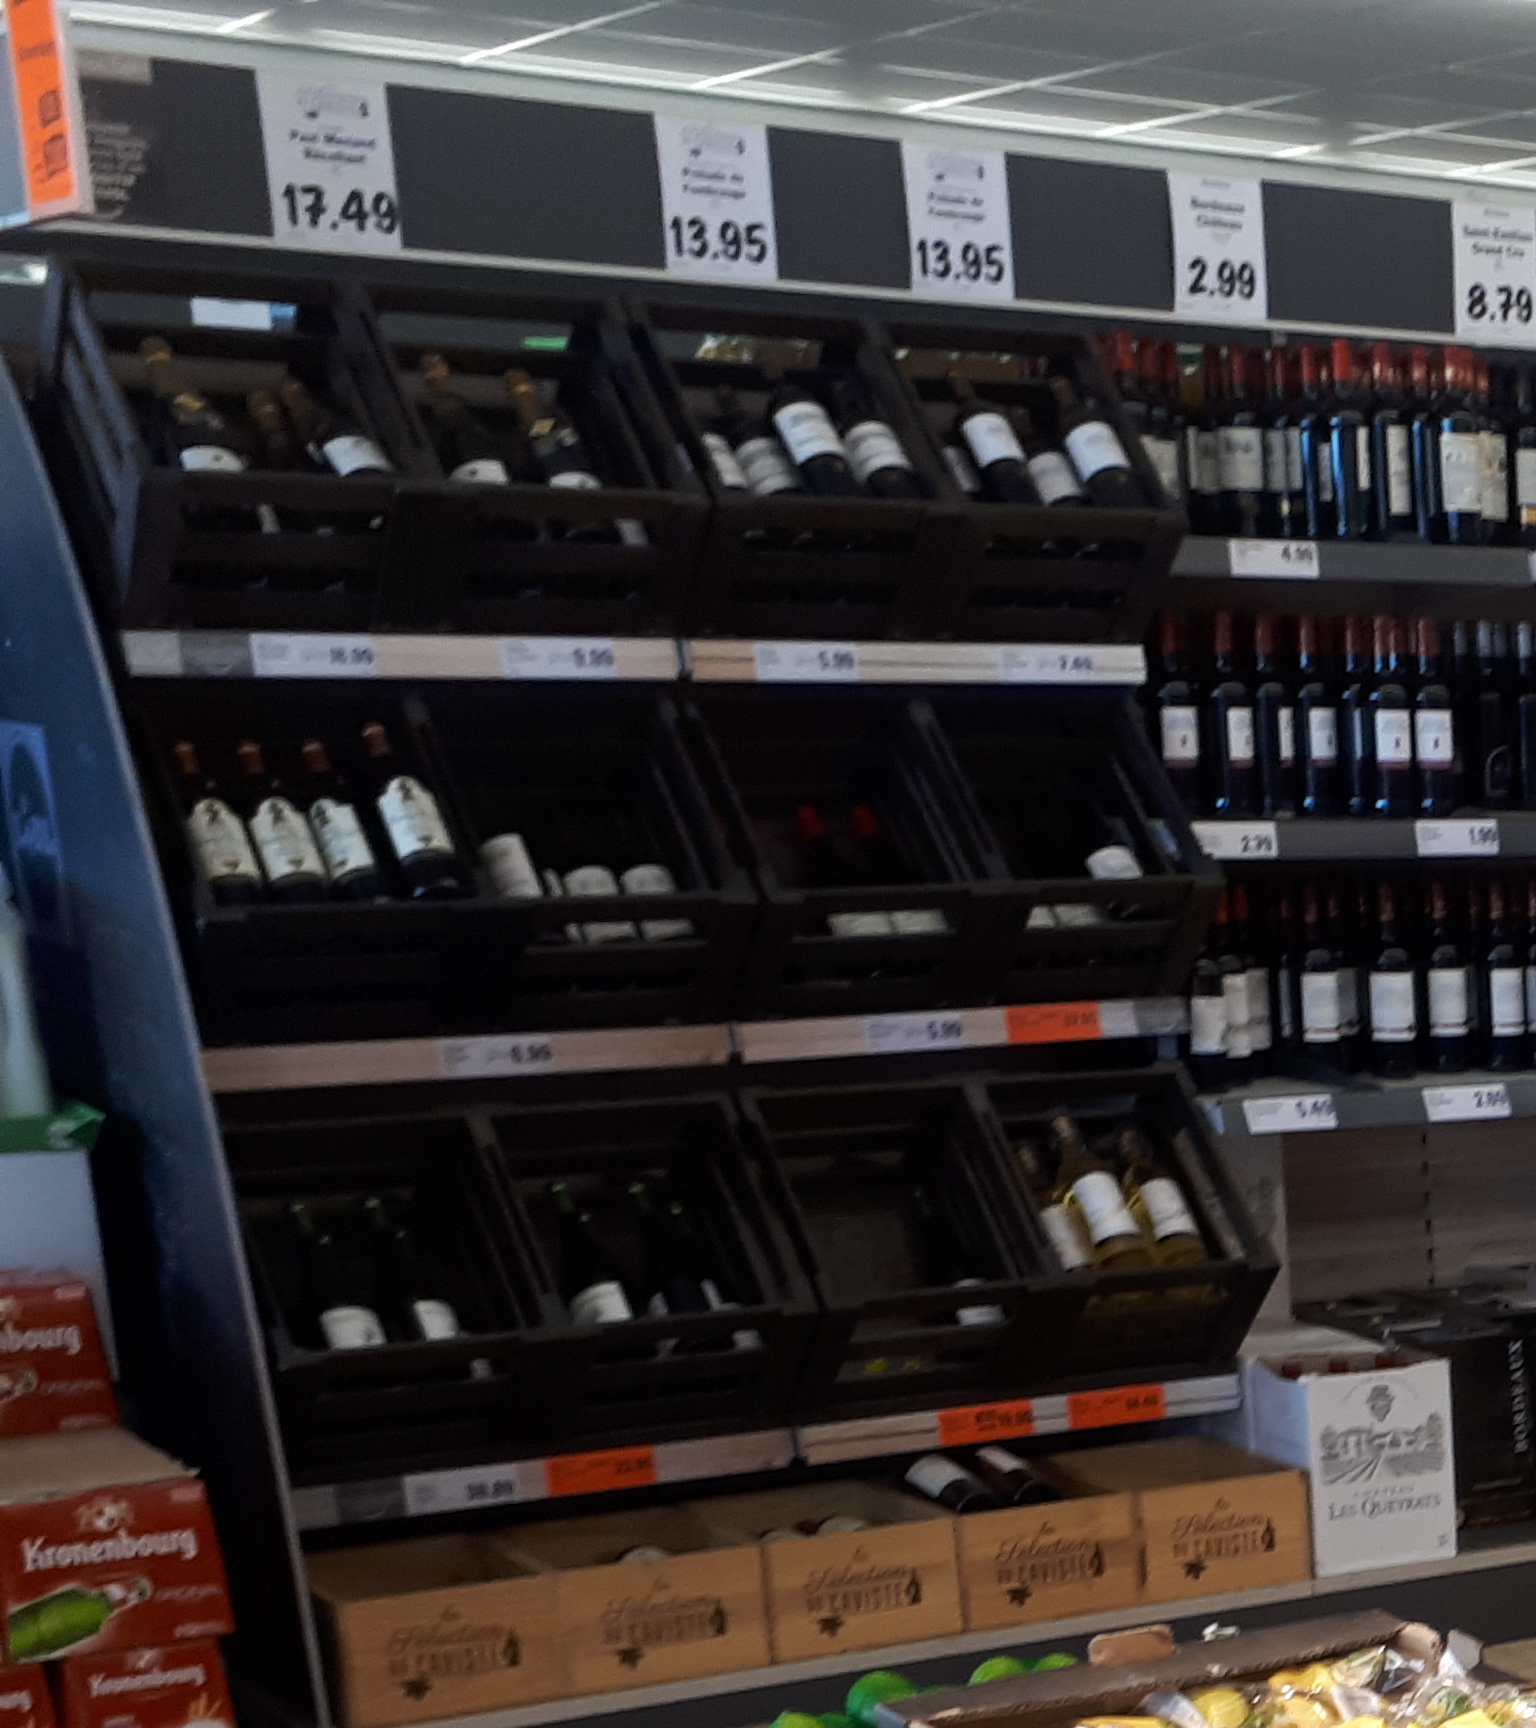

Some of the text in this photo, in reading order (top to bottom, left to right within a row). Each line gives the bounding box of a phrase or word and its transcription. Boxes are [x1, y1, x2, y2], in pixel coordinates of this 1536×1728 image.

[281, 181, 397, 234] 17.49
[670, 215, 768, 263] 13.95
[916, 238, 1005, 282] 13.95
[1187, 256, 1256, 300] 2.99
[1467, 281, 1533, 324] 8.79
[20, 1528, 200, 1574] Kronenbourg
